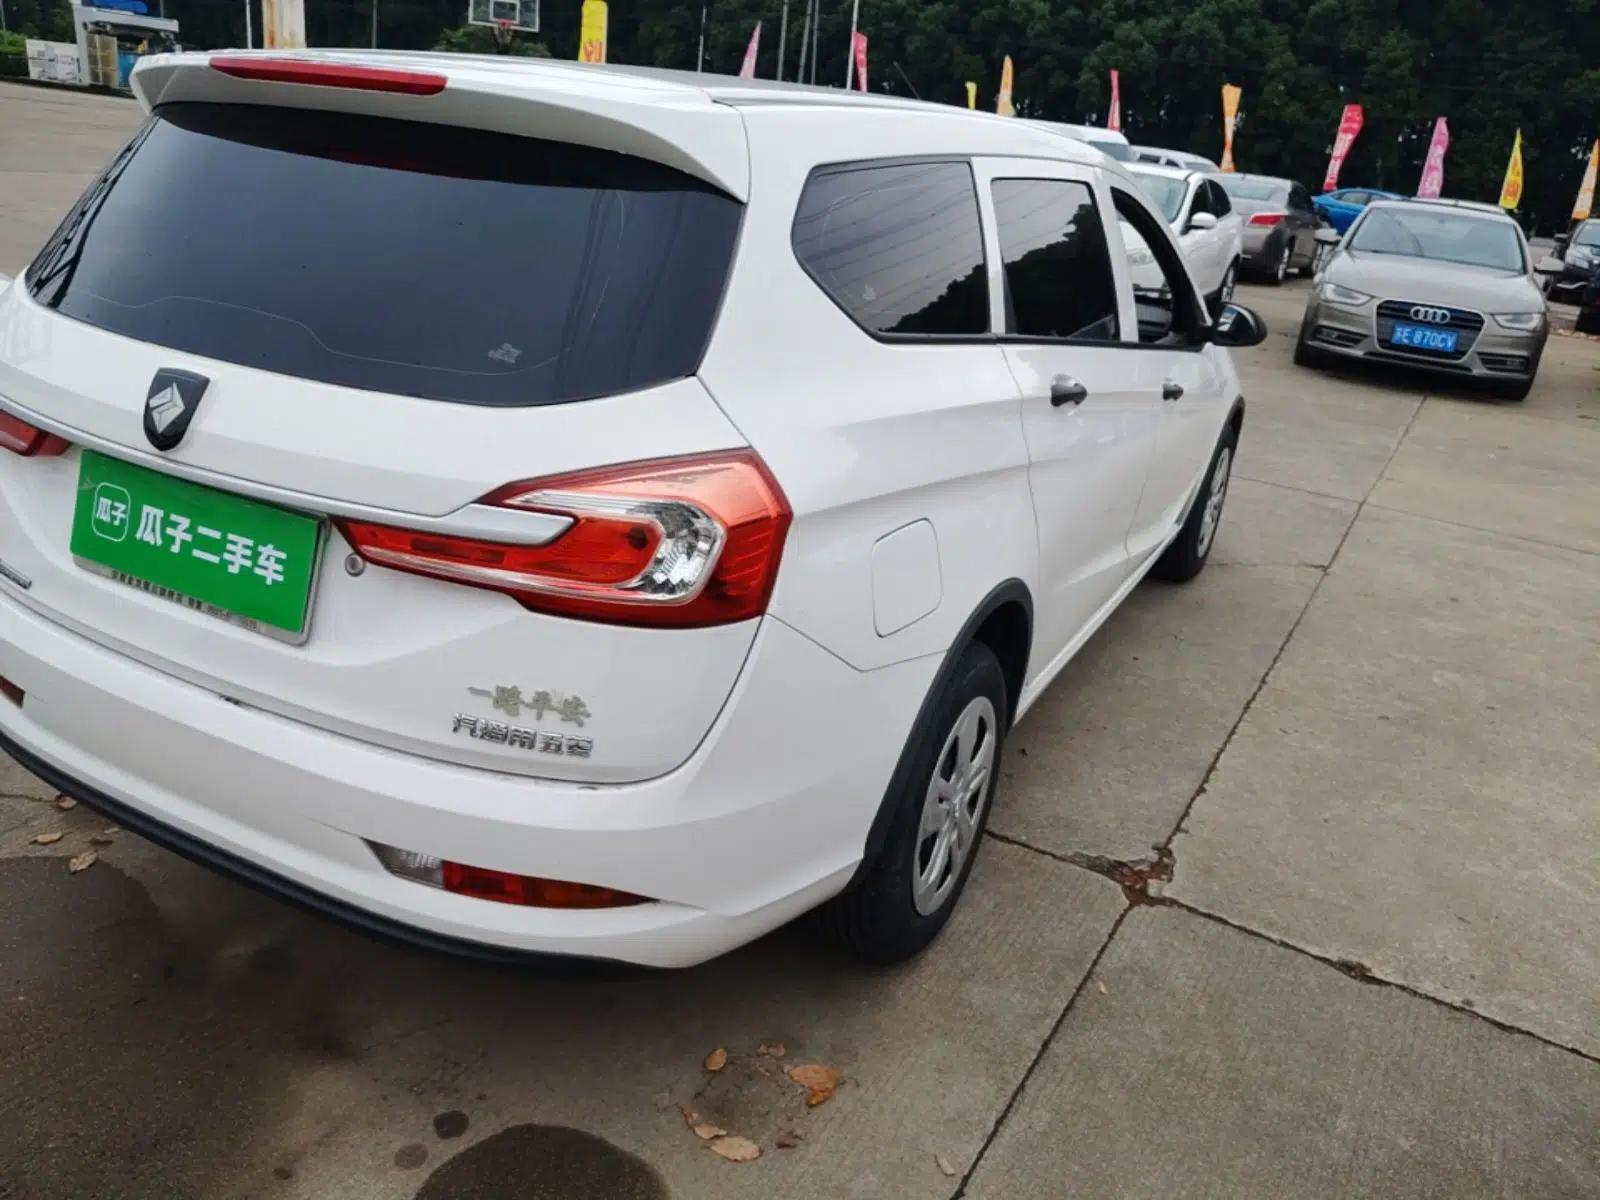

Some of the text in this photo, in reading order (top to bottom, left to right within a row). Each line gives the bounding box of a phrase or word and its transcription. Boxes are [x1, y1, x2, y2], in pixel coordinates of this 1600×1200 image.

[96, 496, 127, 527] 瓜子
[135, 503, 287, 585] 瓜子二手车
